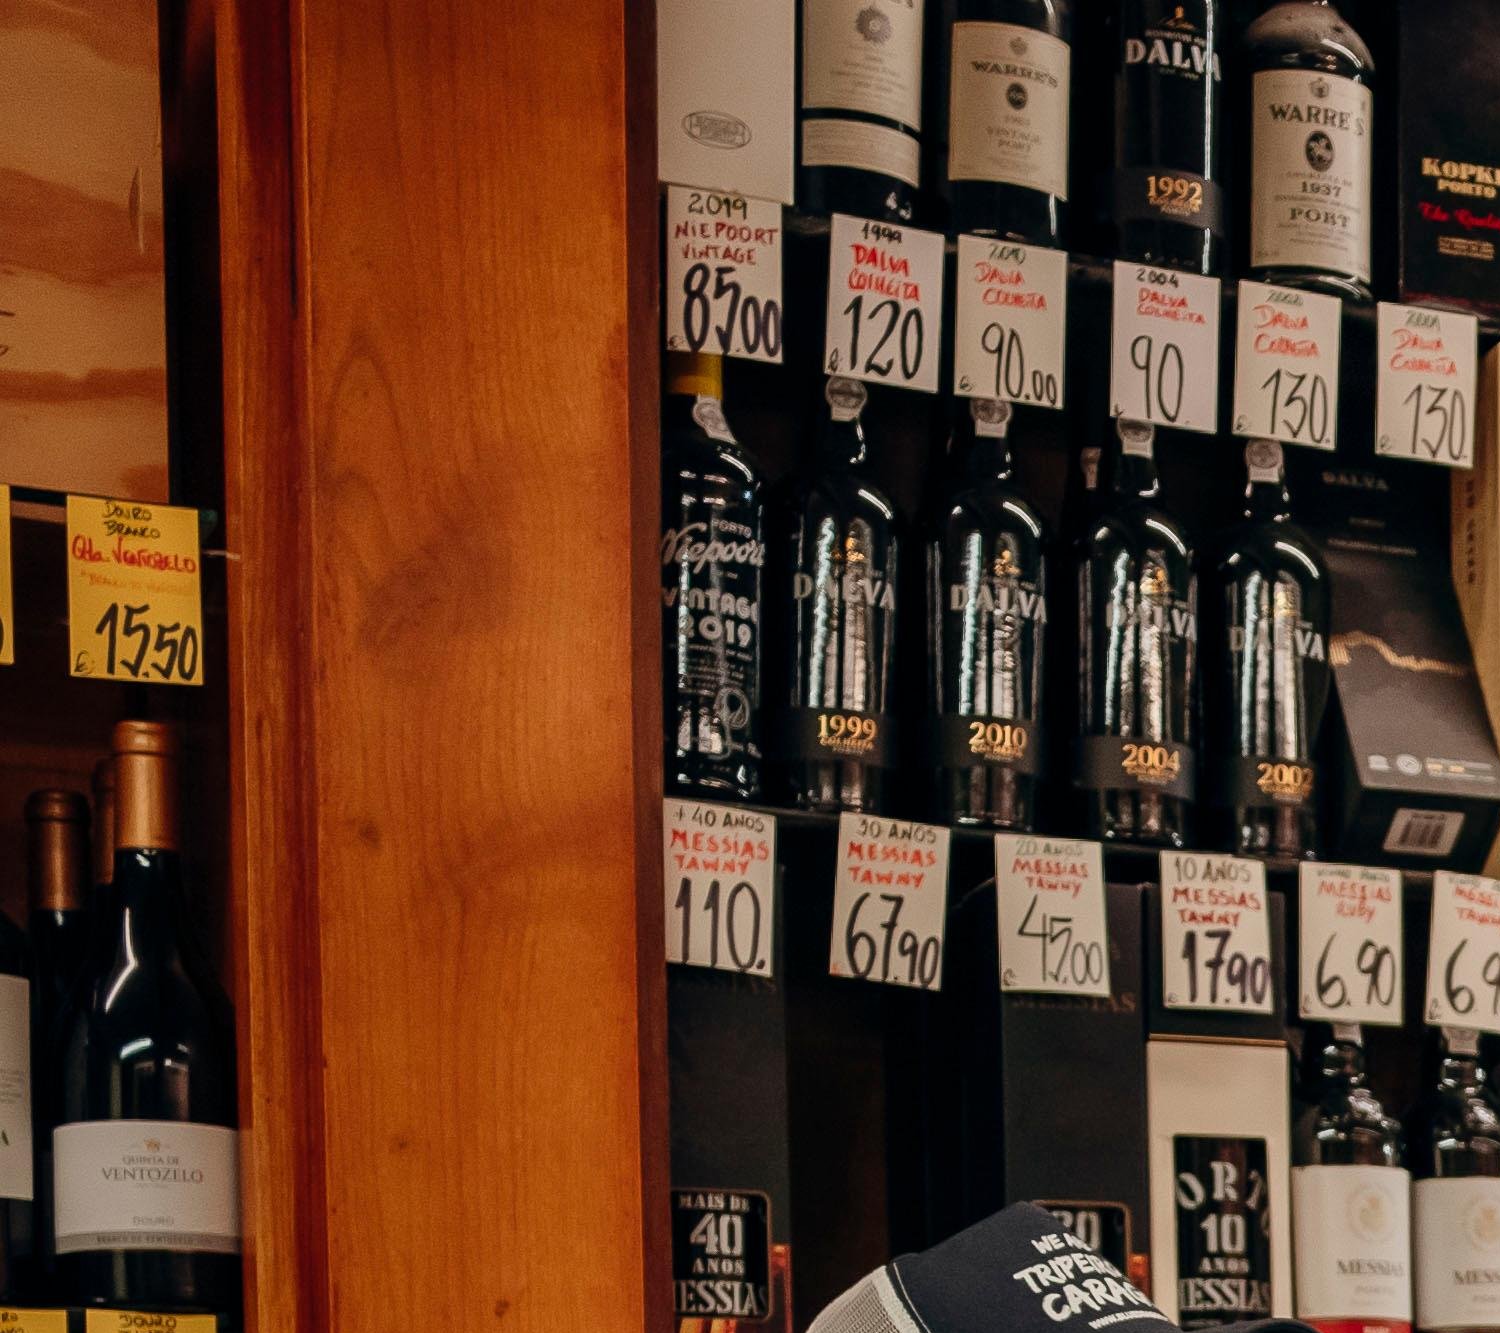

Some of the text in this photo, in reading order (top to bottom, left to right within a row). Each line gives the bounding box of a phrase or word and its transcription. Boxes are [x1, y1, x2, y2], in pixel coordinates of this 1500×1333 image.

[851, 243, 911, 277] DALVA
[842, 297, 925, 381] 120
[97, 601, 199, 680] 15.50
[817, 714, 878, 744] 1999
[968, 721, 1028, 752] 2010
[1120, 743, 1181, 774] 2004
[691, 805, 719, 830] 40
[723, 809, 766, 832] ANOS
[670, 828, 769, 860] MESSIAS
[847, 841, 937, 868] MESSIAS
[673, 855, 749, 876] TAWNY
[848, 865, 924, 890] TAWNY
[1011, 856, 1089, 879] MESSIAS
[1174, 858, 1251, 885] 10 ANOS
[1171, 885, 1261, 911] MESSIAS
[1176, 907, 1241, 929] TAWNY
[689, 1212, 744, 1257] 40
[1031, 1232, 1066, 1255] WE
[1199, 1213, 1246, 1254] 10
[692, 1257, 745, 1276] ANOS
